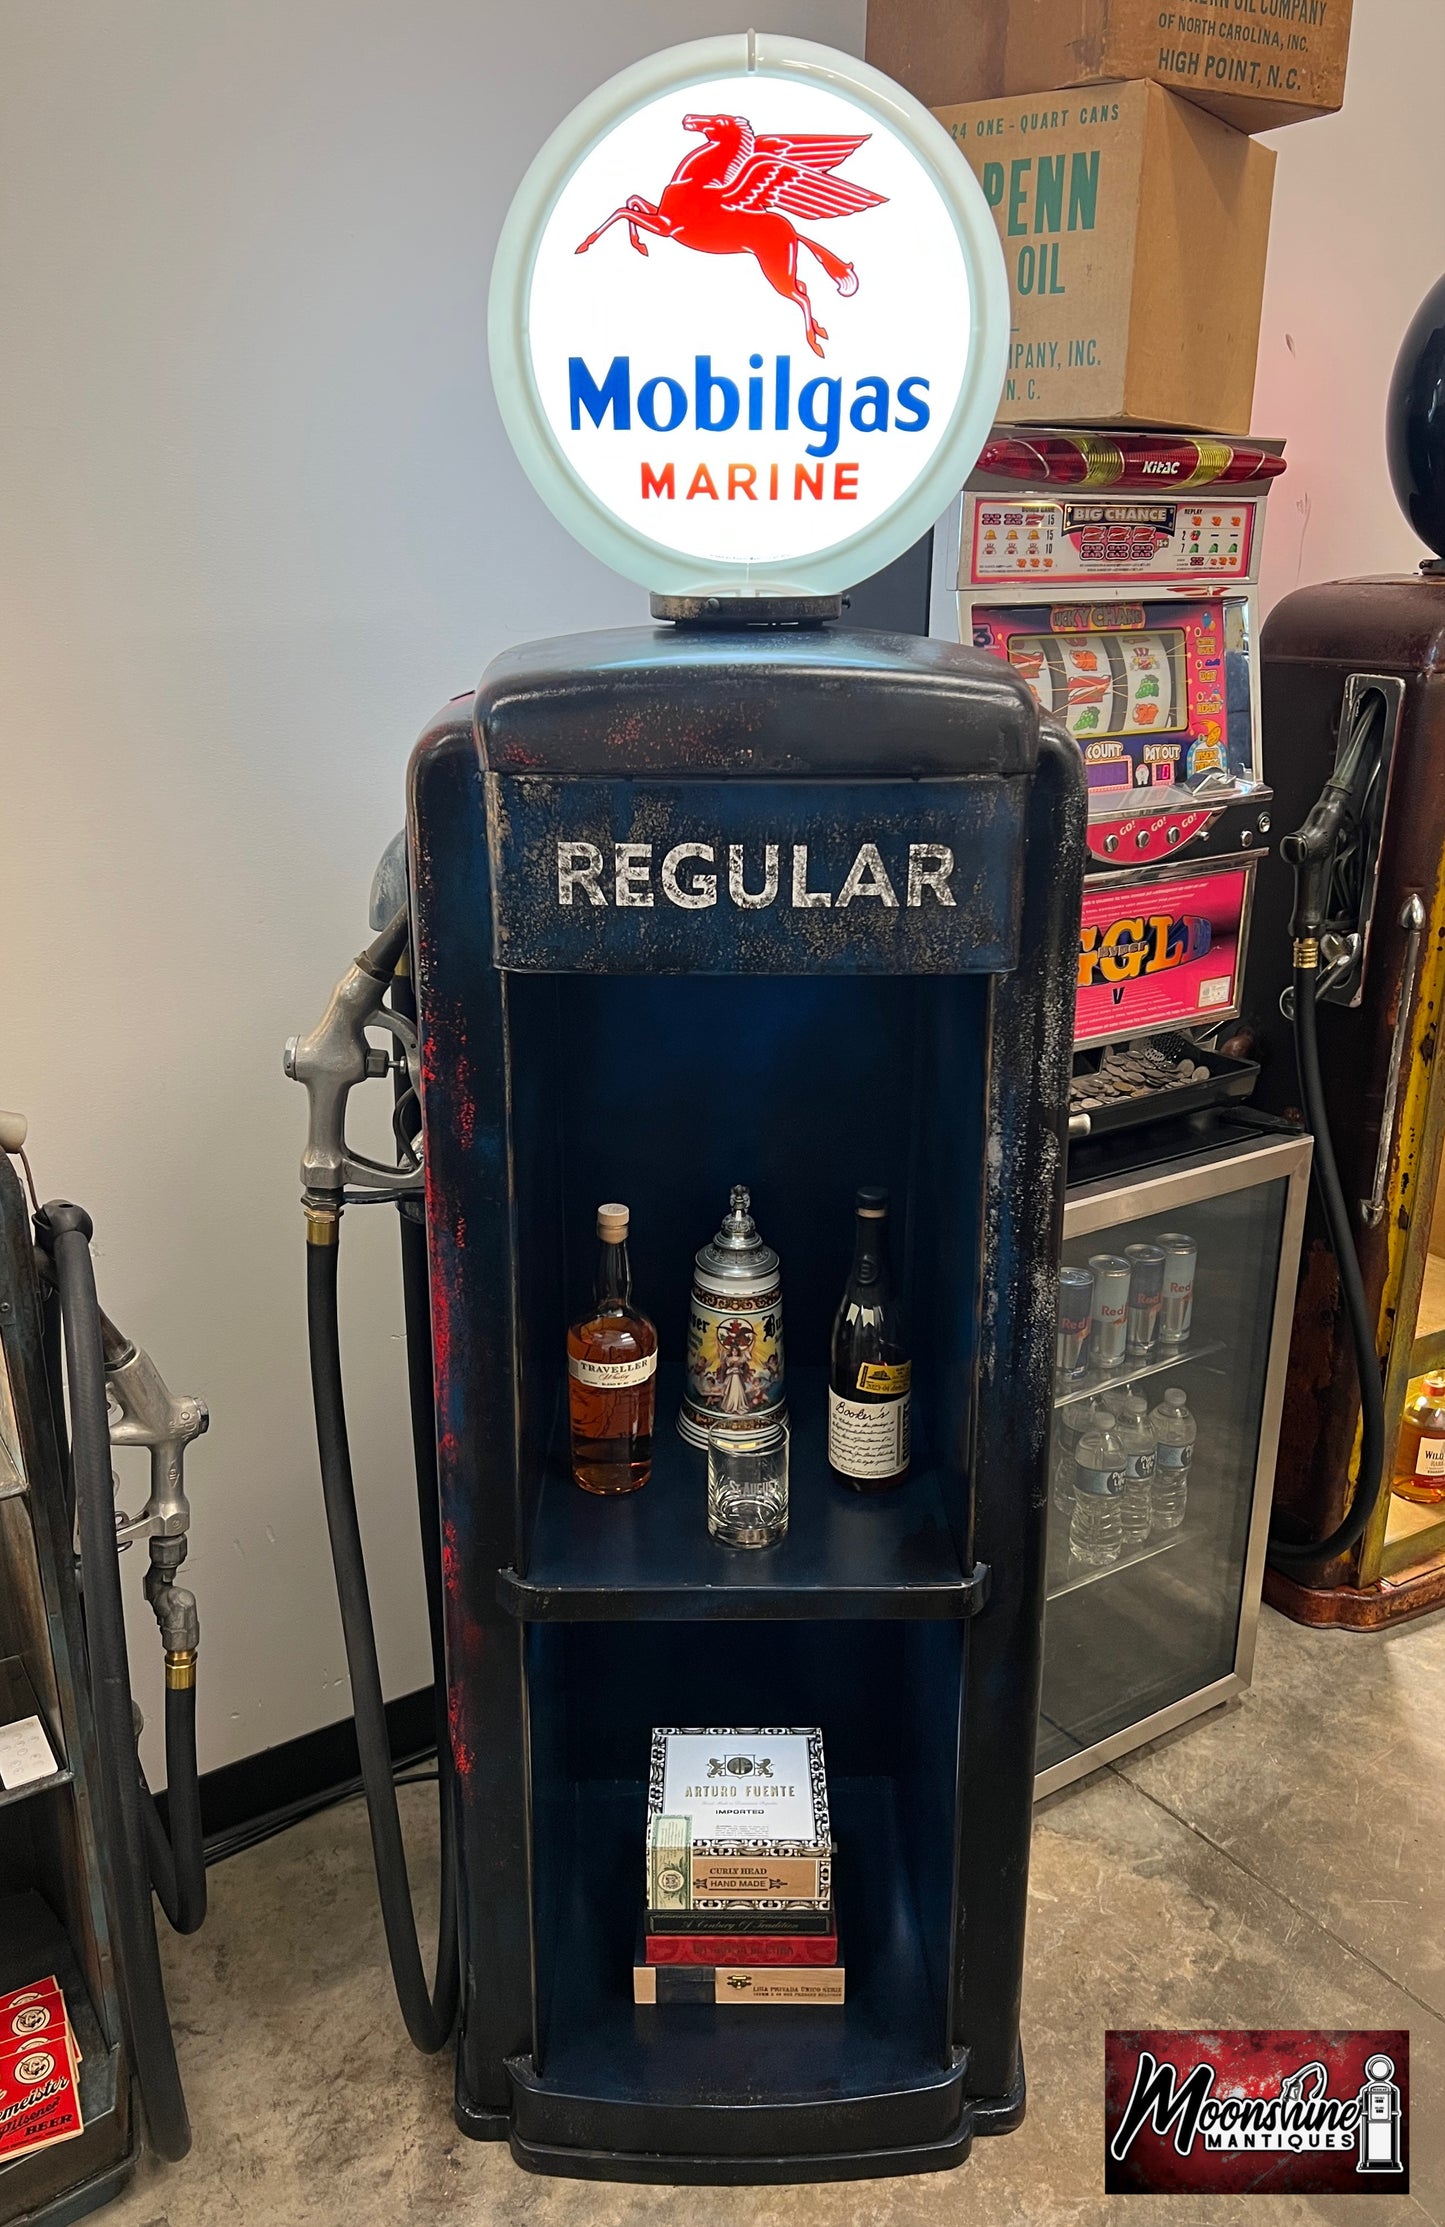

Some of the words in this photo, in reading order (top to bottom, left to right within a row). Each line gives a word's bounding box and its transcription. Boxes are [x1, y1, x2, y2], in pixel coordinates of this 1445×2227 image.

[1260, 0, 1327, 26] COMPANY
[1159, 13, 1175, 28] OF
[1178, 17, 1216, 36] NORTH
[1219, 22, 1284, 51] CAROLINA,
[1287, 34, 1309, 53] INC.
[1158, 48, 1199, 76] HIGH
[1204, 55, 1261, 89] POINT,
[952, 123, 967, 140] 24
[1079, 104, 1119, 125] CANS
[982, 150, 1100, 237] PENN
[1017, 242, 1066, 296] OIL
[1009, 341, 1061, 371] PANY,
[1068, 339, 1101, 367] INC.
[568, 353, 931, 458] Mobilgas
[640, 462, 860, 501] MARINE
[1047, 514, 1055, 525] 15
[1073, 507, 1102, 520] BIG
[1104, 507, 1167, 521] CHANCE
[1046, 529, 1054, 540] 15
[1045, 543, 1053, 554] 10
[1086, 743, 1123, 759] COUNT
[1119, 820, 1136, 836] GO!
[1150, 816, 1167, 832] GO!
[1181, 813, 1197, 828] GO!
[557, 841, 958, 909] REGULAR
[1112, 986, 1125, 1005] V
[1171, 1282, 1191, 1293] Red
[1137, 1292, 1160, 1304] Red
[1101, 1305, 1124, 1316] Red
[1062, 1317, 1086, 1329] Red
[581, 1359, 648, 1374] TRAVELLER
[836, 1401, 890, 1421] Booker's
[685, 1785, 737, 1798] ARTURO
[745, 1785, 796, 1798] FUENTE
[709, 1867, 739, 1875] CURLY
[740, 1867, 768, 1875] HEAD
[0, 2075, 69, 2121] meister
[25, 2114, 73, 2137] BEER
